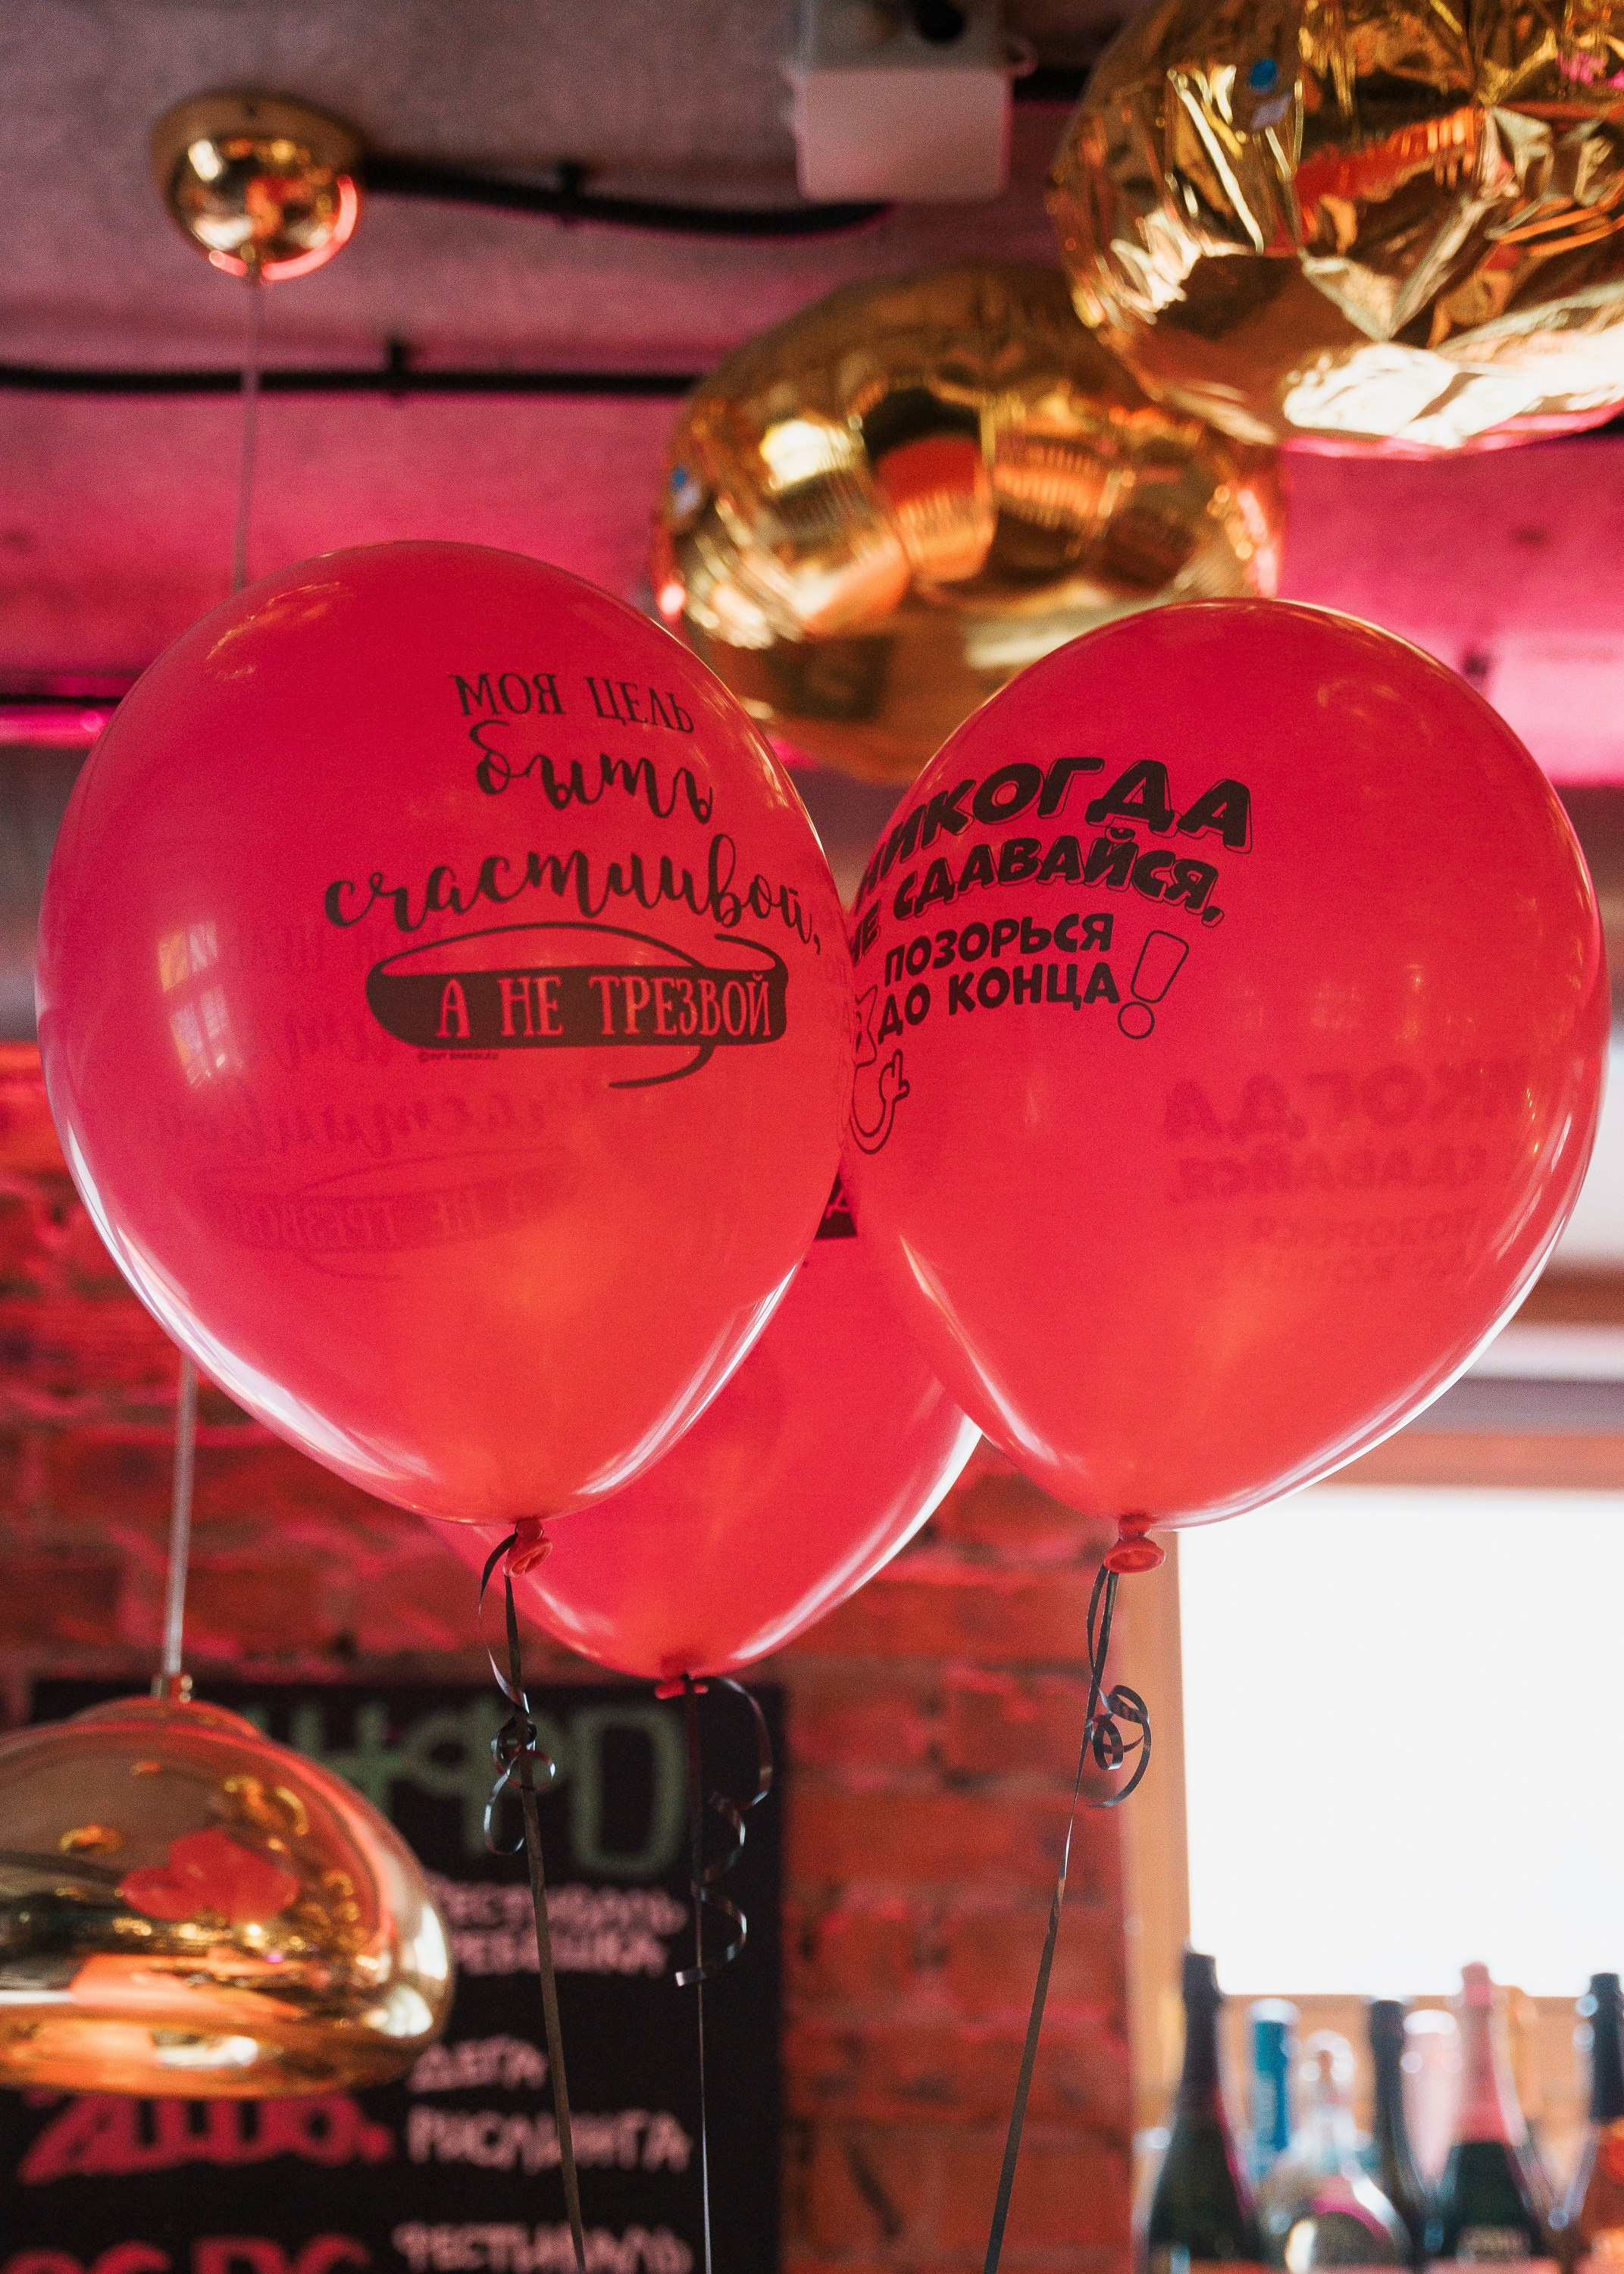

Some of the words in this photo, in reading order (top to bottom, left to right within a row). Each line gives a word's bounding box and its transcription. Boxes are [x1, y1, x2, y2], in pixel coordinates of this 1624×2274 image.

[449, 672, 565, 717] МОЯ
[584, 675, 695, 735] ЦЕЛЬ
[468, 719, 713, 825] быть
[854, 756, 1253, 915] НИКОГДА
[893, 824, 1225, 927] СДАВАЙСЯ,
[324, 833, 821, 955] счастливой,
[884, 913, 1116, 987] ПОЗОРЬСЯ
[435, 978, 471, 1038] А
[499, 975, 565, 1038] НЕ
[588, 972, 772, 1038] ТРЕЗВОЙ
[877, 982, 932, 1045] ДО
[246, 1684, 687, 1878] НФО
